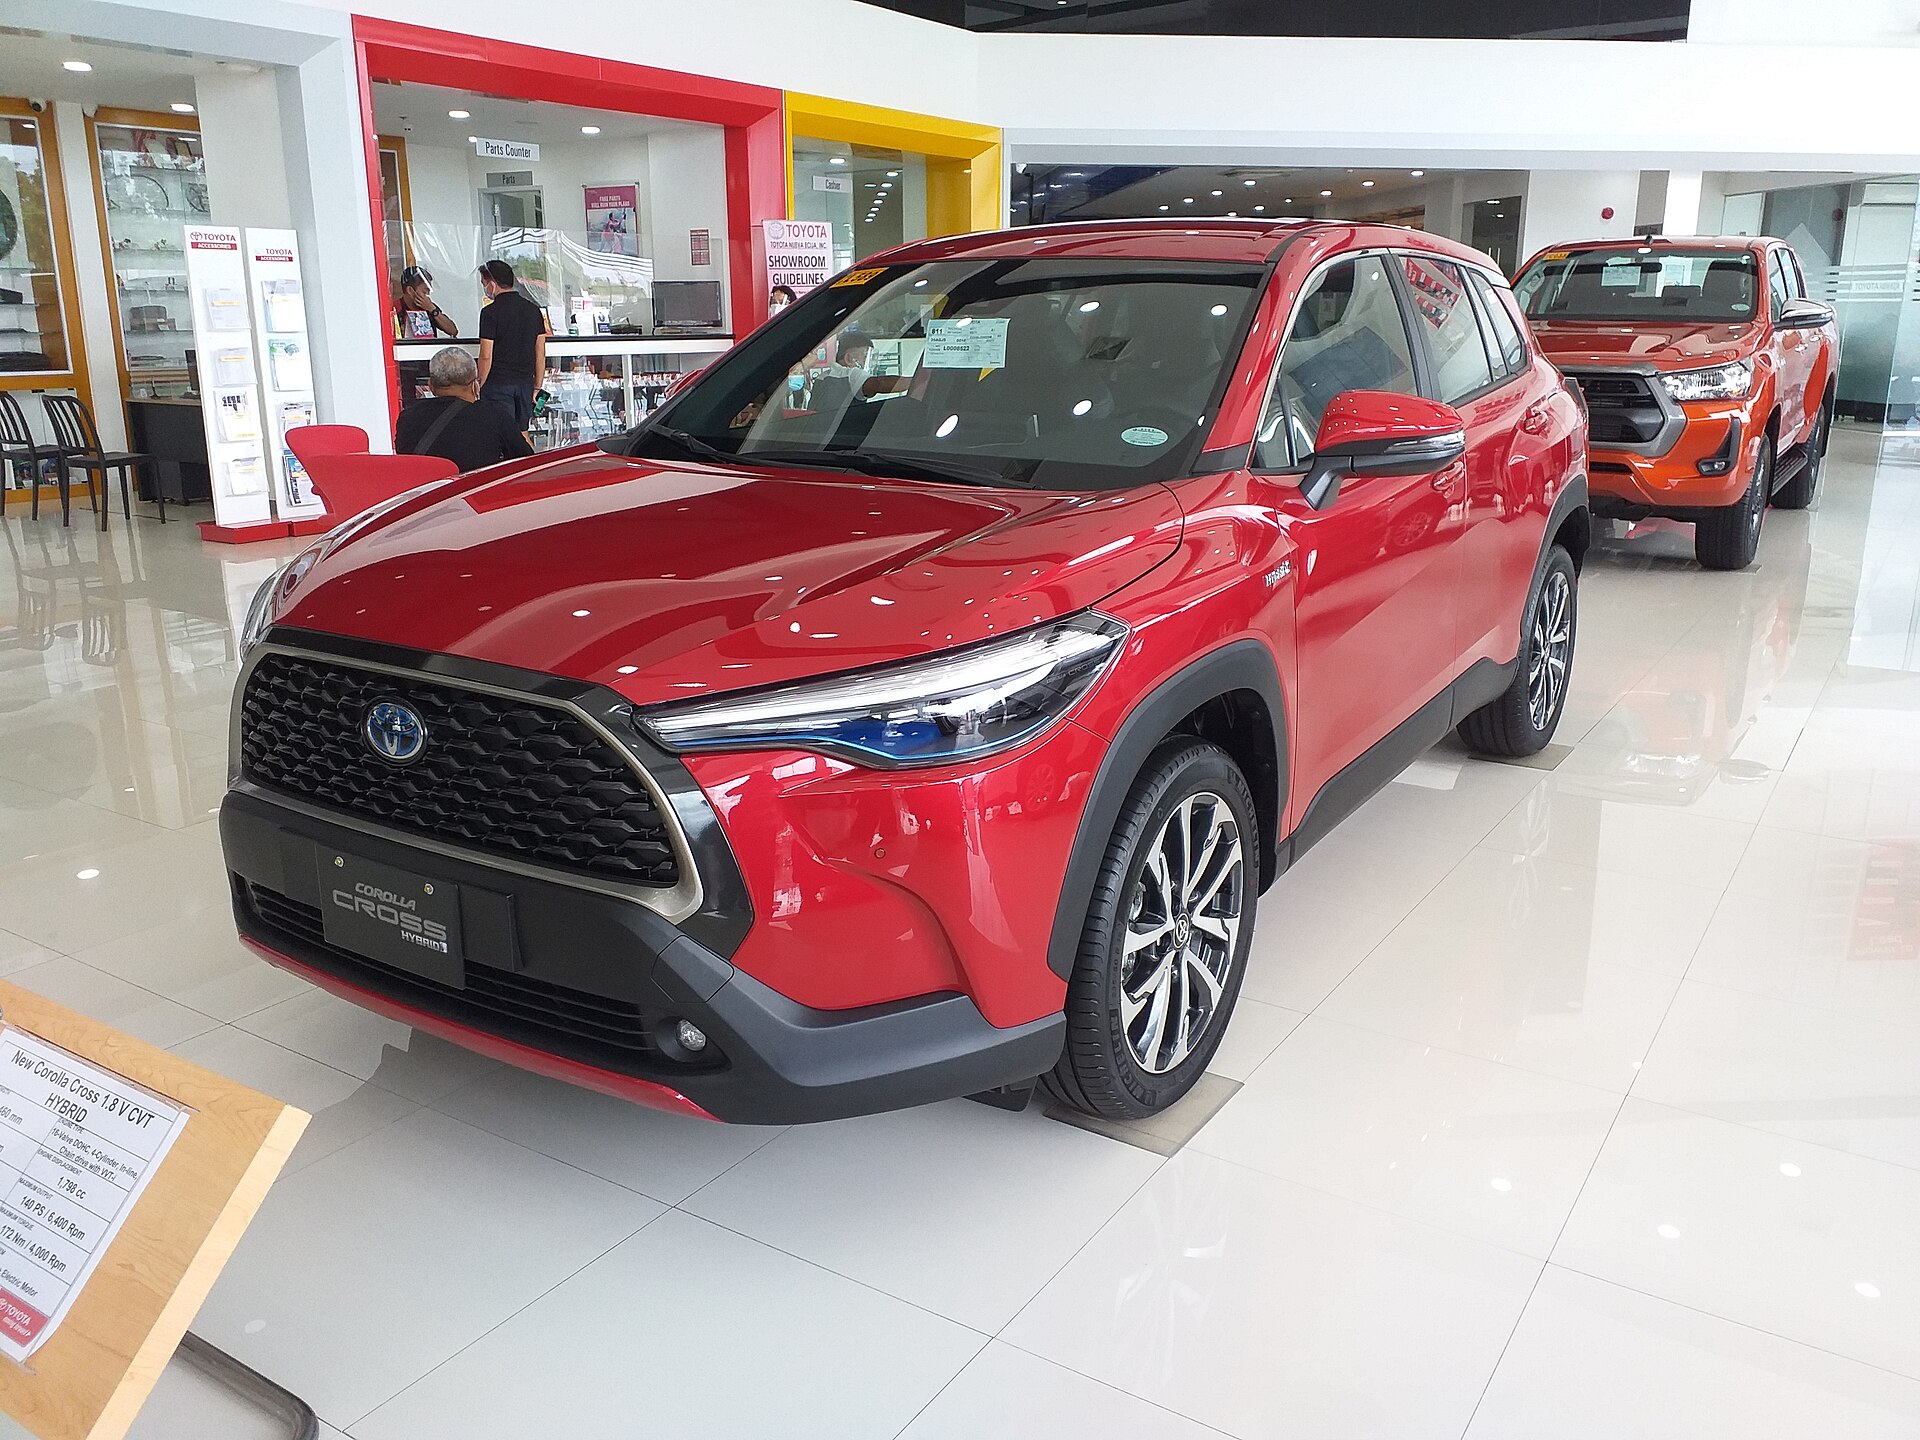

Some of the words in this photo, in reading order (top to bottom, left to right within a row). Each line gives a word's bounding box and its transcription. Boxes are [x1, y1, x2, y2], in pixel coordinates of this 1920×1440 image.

[485, 141, 504, 156] Parts
[505, 143, 531, 158] Counter
[502, 174, 516, 184] Parts
[203, 233, 236, 241] TOYOTA
[786, 224, 827, 238] TOYOTA
[768, 255, 826, 268] SHOWROOM
[772, 273, 824, 286] GUIDELINES
[355, 882, 416, 911] COROLLA
[332, 889, 447, 941] CROSS
[400, 930, 440, 952] HYBRID
[11, 1050, 35, 1070] New
[34, 1061, 69, 1088] Corolla
[70, 1079, 100, 1103] Cross
[101, 1094, 119, 1112] 1.8
[118, 1101, 130, 1116] V
[128, 1107, 155, 1128] CVT
[44, 1093, 88, 1123] HYBRID
[72, 1139, 91, 1154] DOHC,
[59, 1146, 76, 1158] Chain
[74, 1155, 89, 1166] drive
[88, 1162, 101, 1173] with
[57, 1176, 78, 1194] 1,798
[75, 1189, 86, 1199] cc
[20, 1196, 35, 1210] 140
[32, 1203, 46, 1216] PS
[43, 1209, 50, 1218] /
[47, 1212, 68, 1230] 6,400
[66, 1223, 86, 1240] Rpm
[0, 1225, 15, 1240] 172
[12, 1232, 26, 1247] Nm
[23, 1240, 32, 1249] /
[28, 1243, 50, 1261] 4,000
[47, 1254, 67, 1272] Rpm
[1, 1269, 22, 1287] Electric
[21, 1281, 38, 1297] Motor
[5, 1304, 31, 1326] TOYOTA
